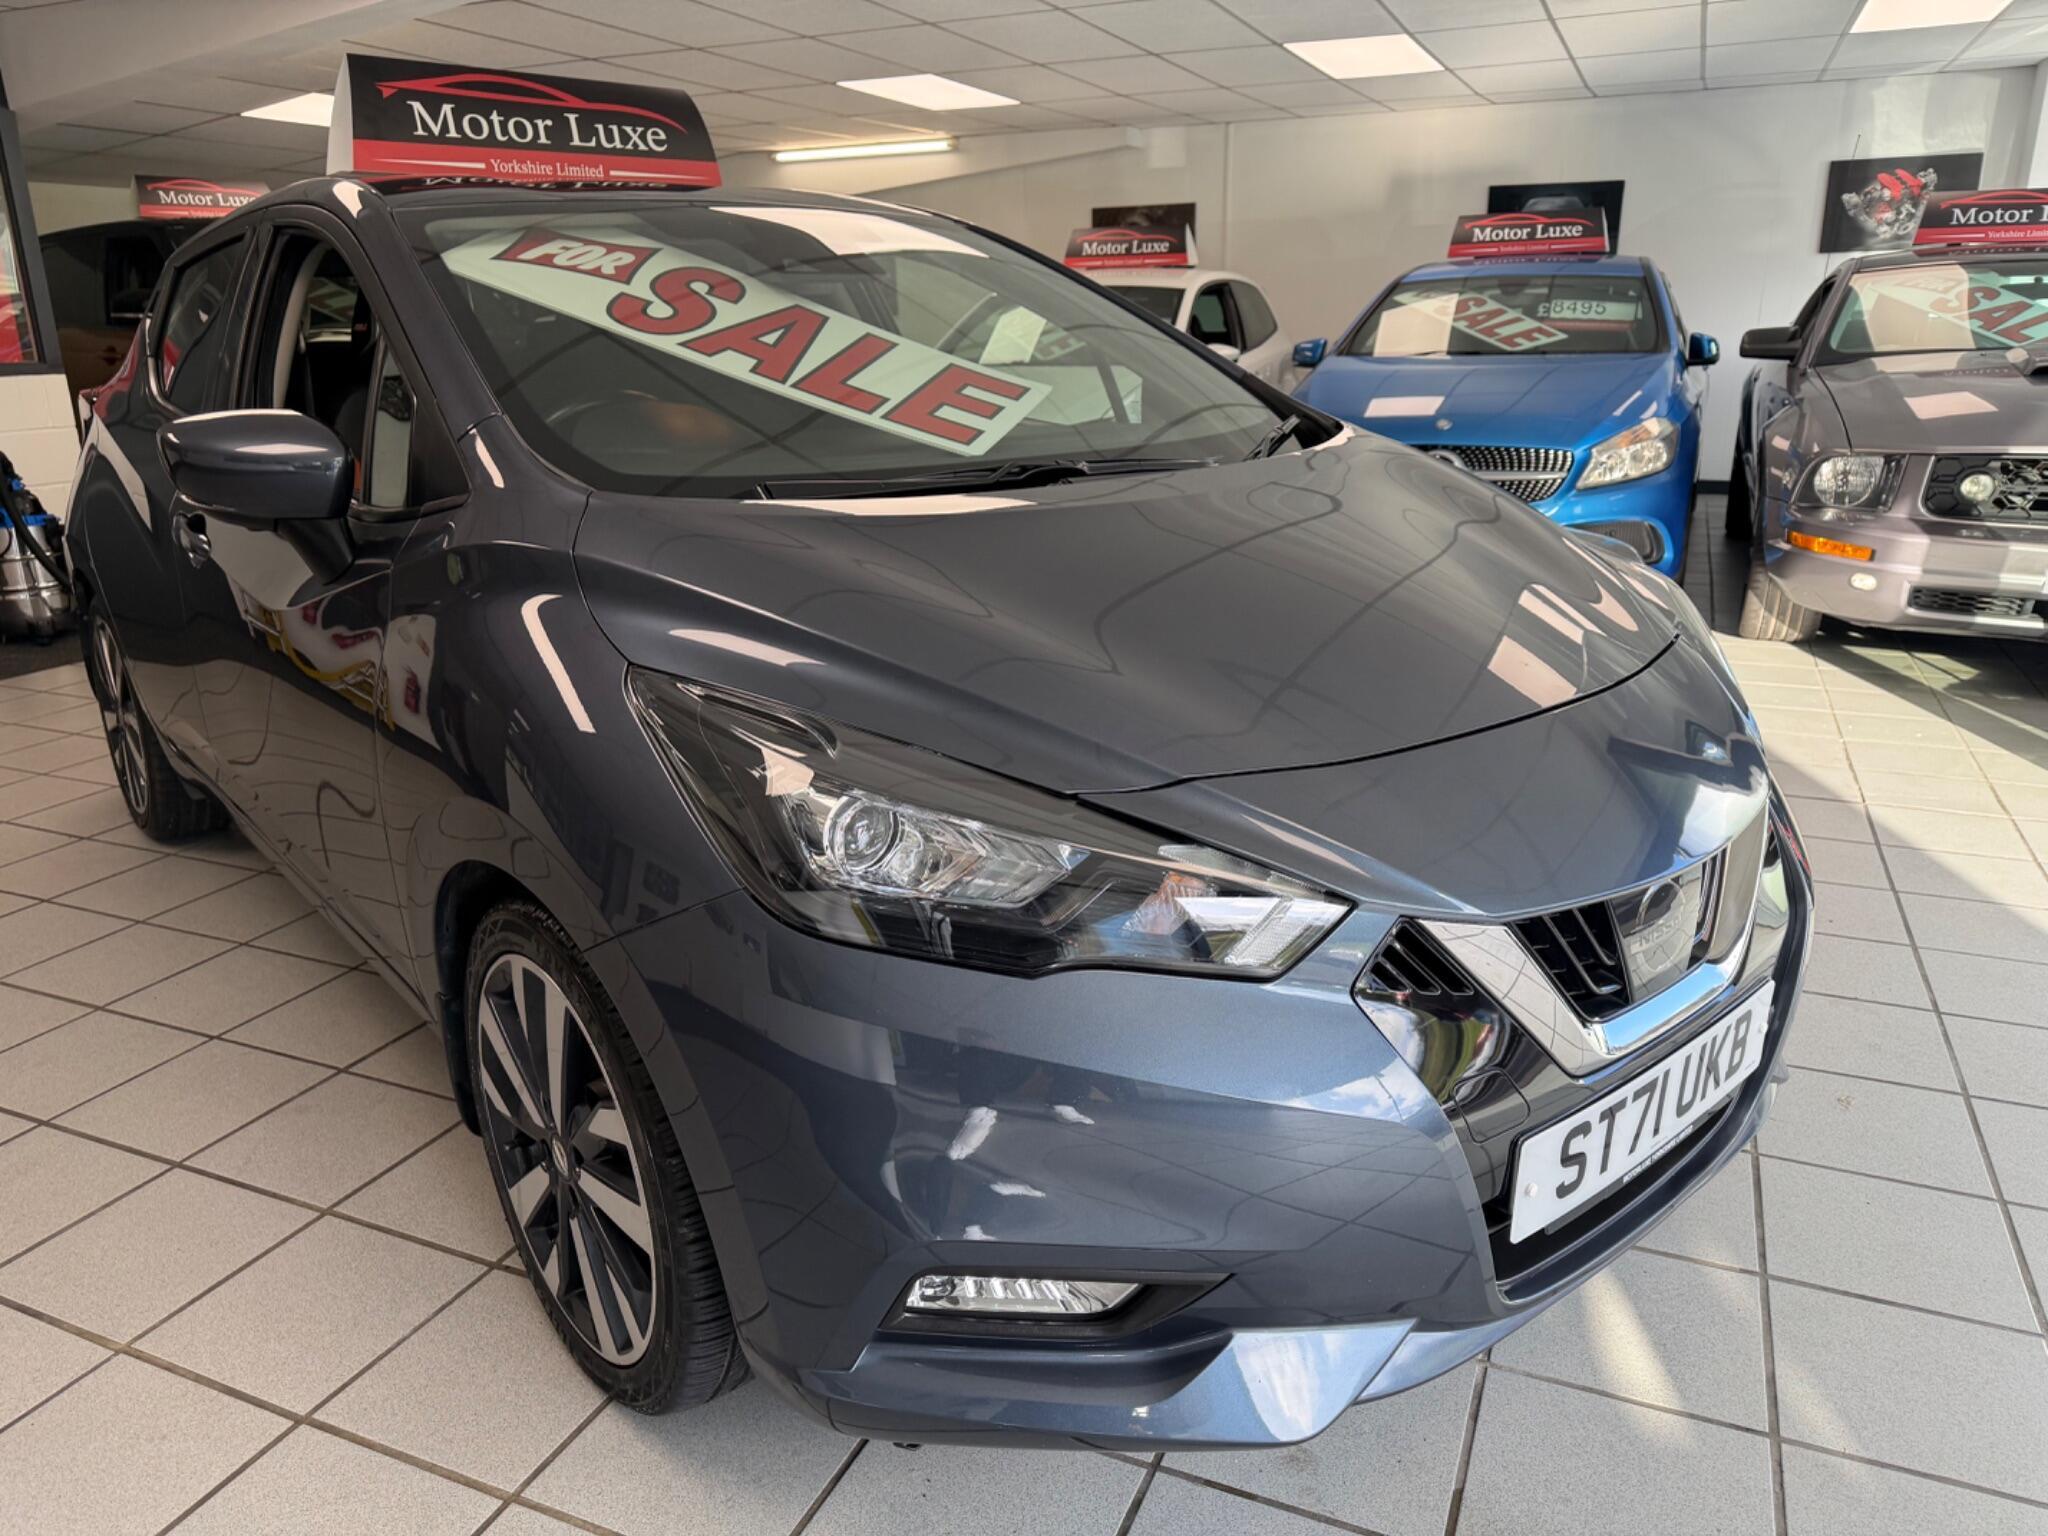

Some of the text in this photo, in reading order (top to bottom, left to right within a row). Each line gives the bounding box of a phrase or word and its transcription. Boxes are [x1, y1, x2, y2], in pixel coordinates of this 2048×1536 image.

[407, 101, 669, 152] Motor Luxe
[490, 158, 605, 178] Yorkshire Limited
[157, 190, 214, 206] Motor
[1949, 207, 2034, 225] Motor
[1472, 224, 1583, 243] Motor Luxe
[1081, 240, 1170, 256] Motor Luxe
[1440, 296, 1556, 349] SALE
[517, 238, 1032, 445] FOR SALE
[1555, 1068, 1671, 1200] ST71
[1675, 1009, 1752, 1119] UKB
